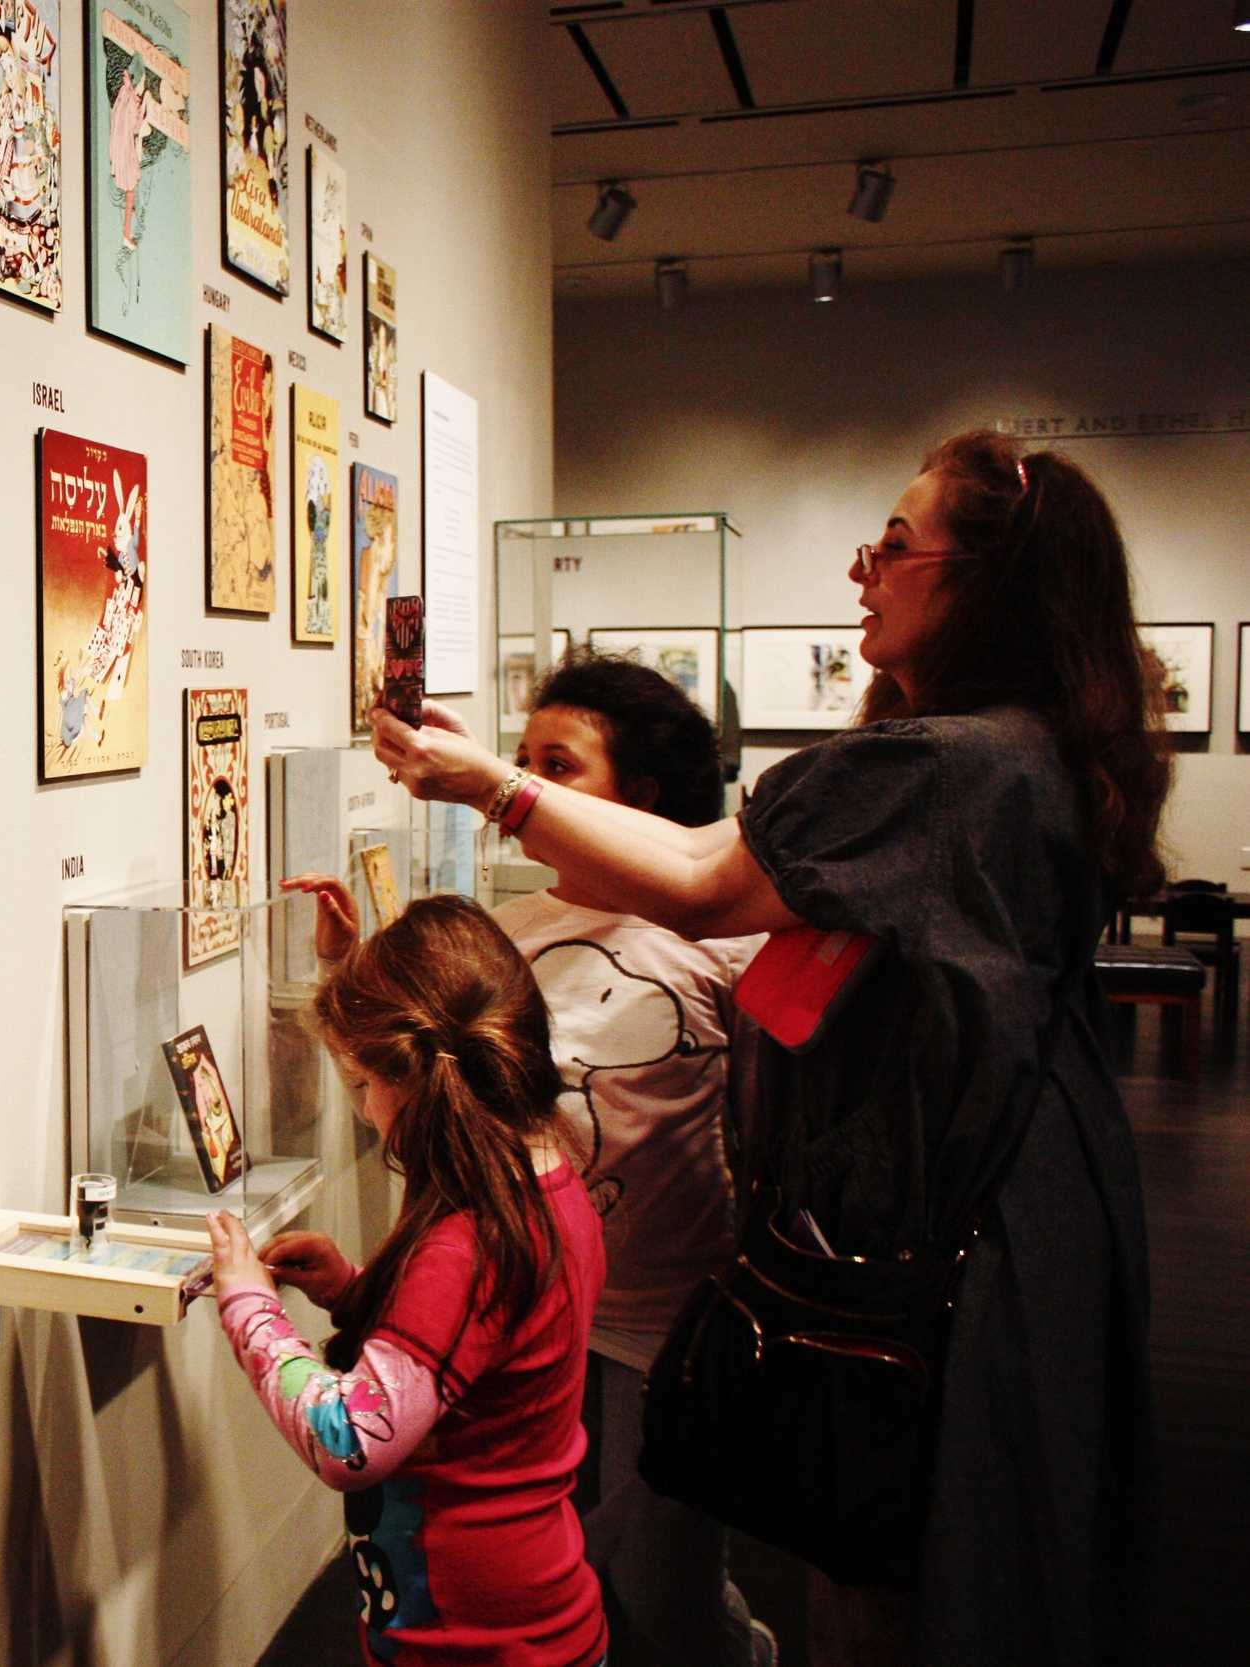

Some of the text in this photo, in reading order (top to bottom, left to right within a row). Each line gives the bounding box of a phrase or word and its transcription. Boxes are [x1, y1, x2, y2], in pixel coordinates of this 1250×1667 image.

[203, 284, 230, 312] HUNGARY
[33, 382, 65, 413] ISRAEL
[1075, 416, 1124, 432] AND
[181, 649, 224, 670] SOUTH KOREA
[61, 854, 85, 880] INDIA
